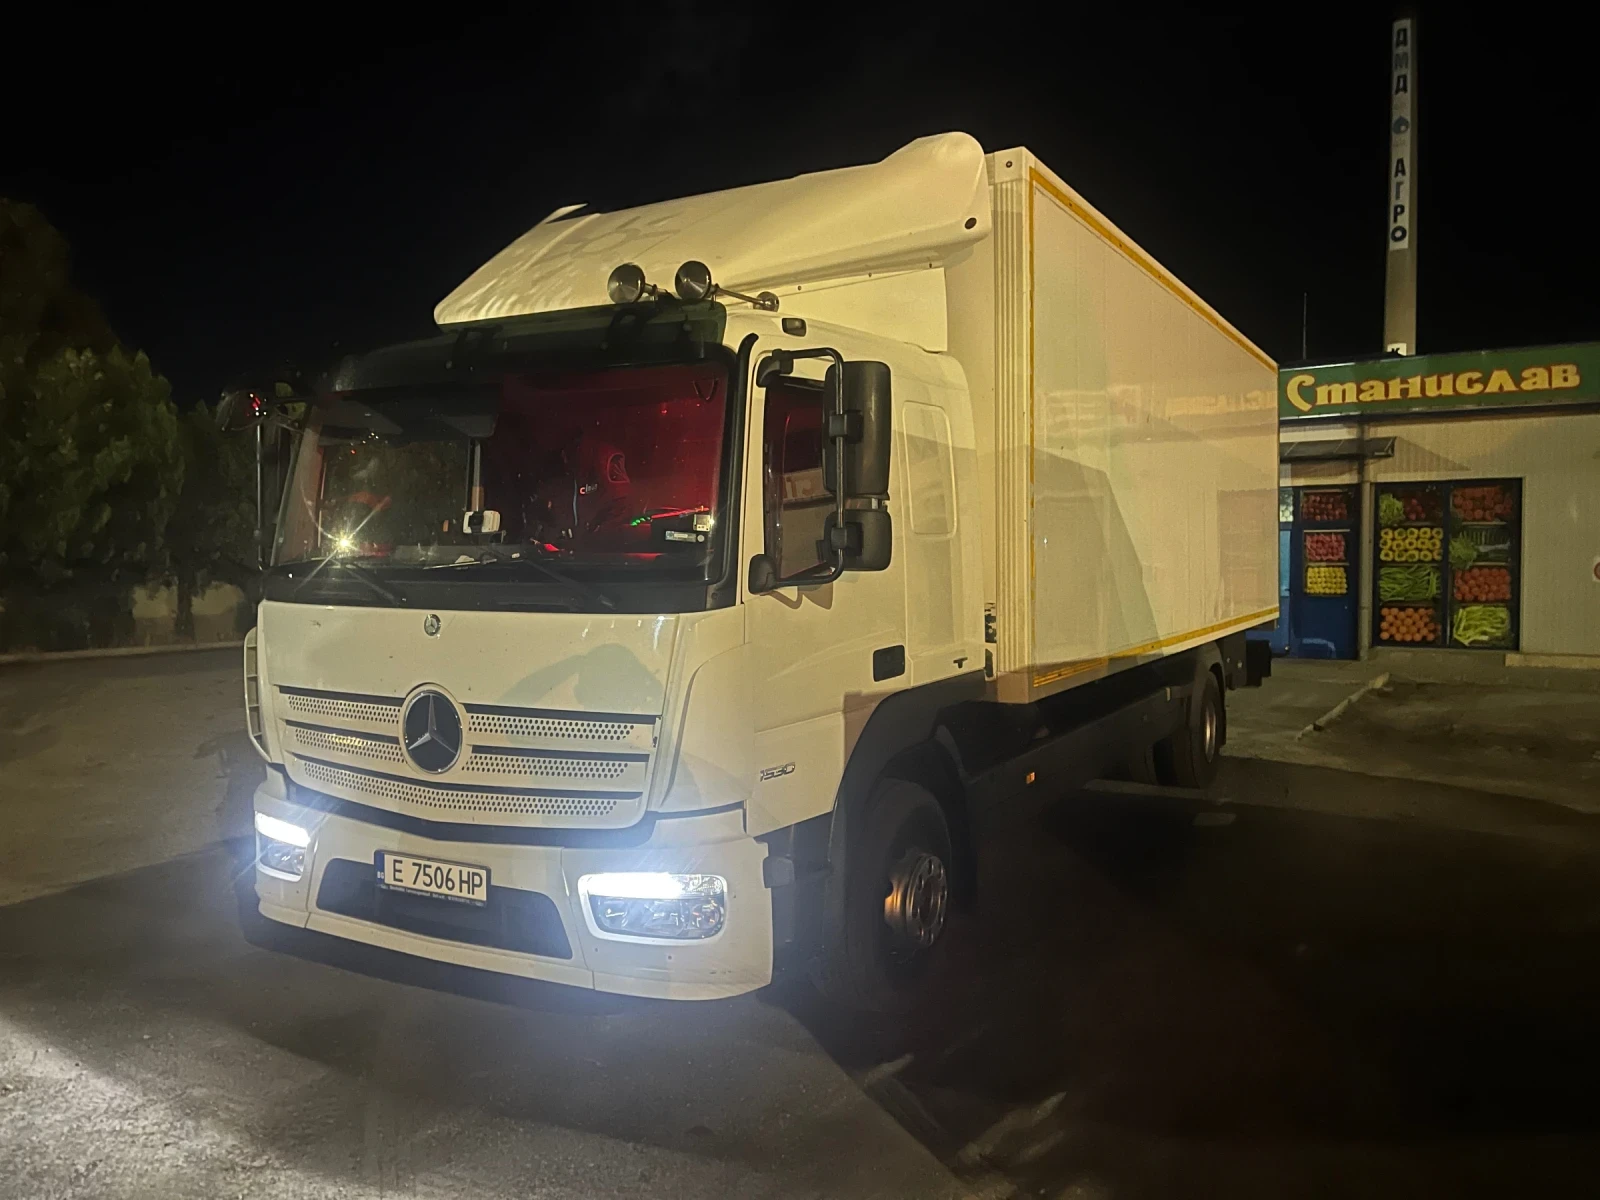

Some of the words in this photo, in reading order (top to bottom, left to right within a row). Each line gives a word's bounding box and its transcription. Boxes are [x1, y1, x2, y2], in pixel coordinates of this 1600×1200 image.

[1390, 157, 1408, 243] АГРО
[1286, 363, 1581, 412] Станислав
[759, 761, 796, 783] 1530
[411, 861, 456, 892] 7506
